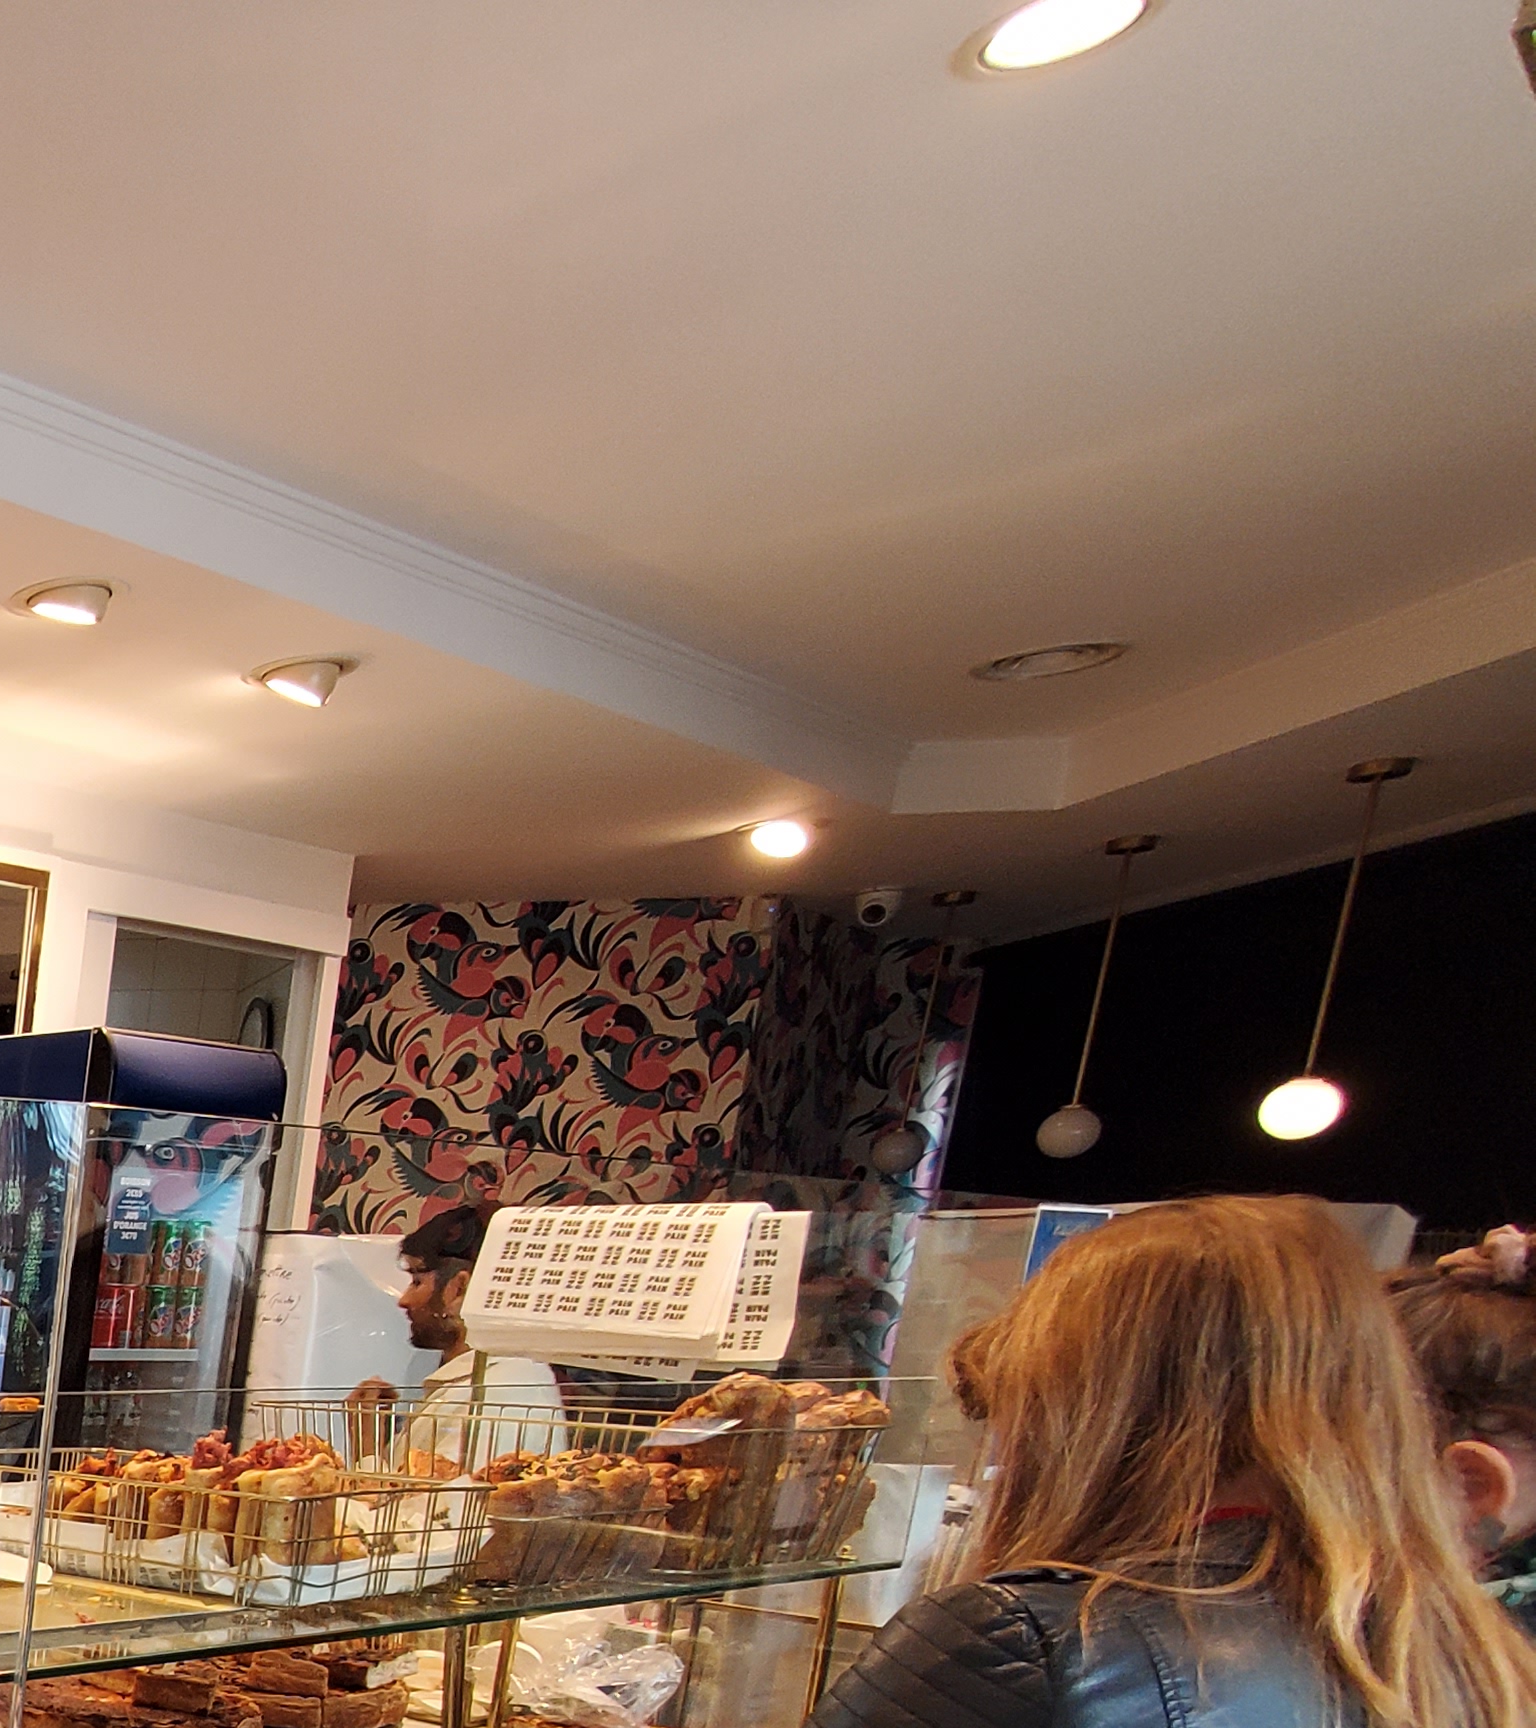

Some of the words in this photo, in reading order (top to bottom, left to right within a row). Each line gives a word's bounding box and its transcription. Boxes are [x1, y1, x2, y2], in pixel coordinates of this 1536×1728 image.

[609, 1230, 632, 1238] PAIN
[664, 1232, 687, 1240] PAIN
[592, 1281, 613, 1289] PAIN
[608, 1308, 630, 1316] PAIN
